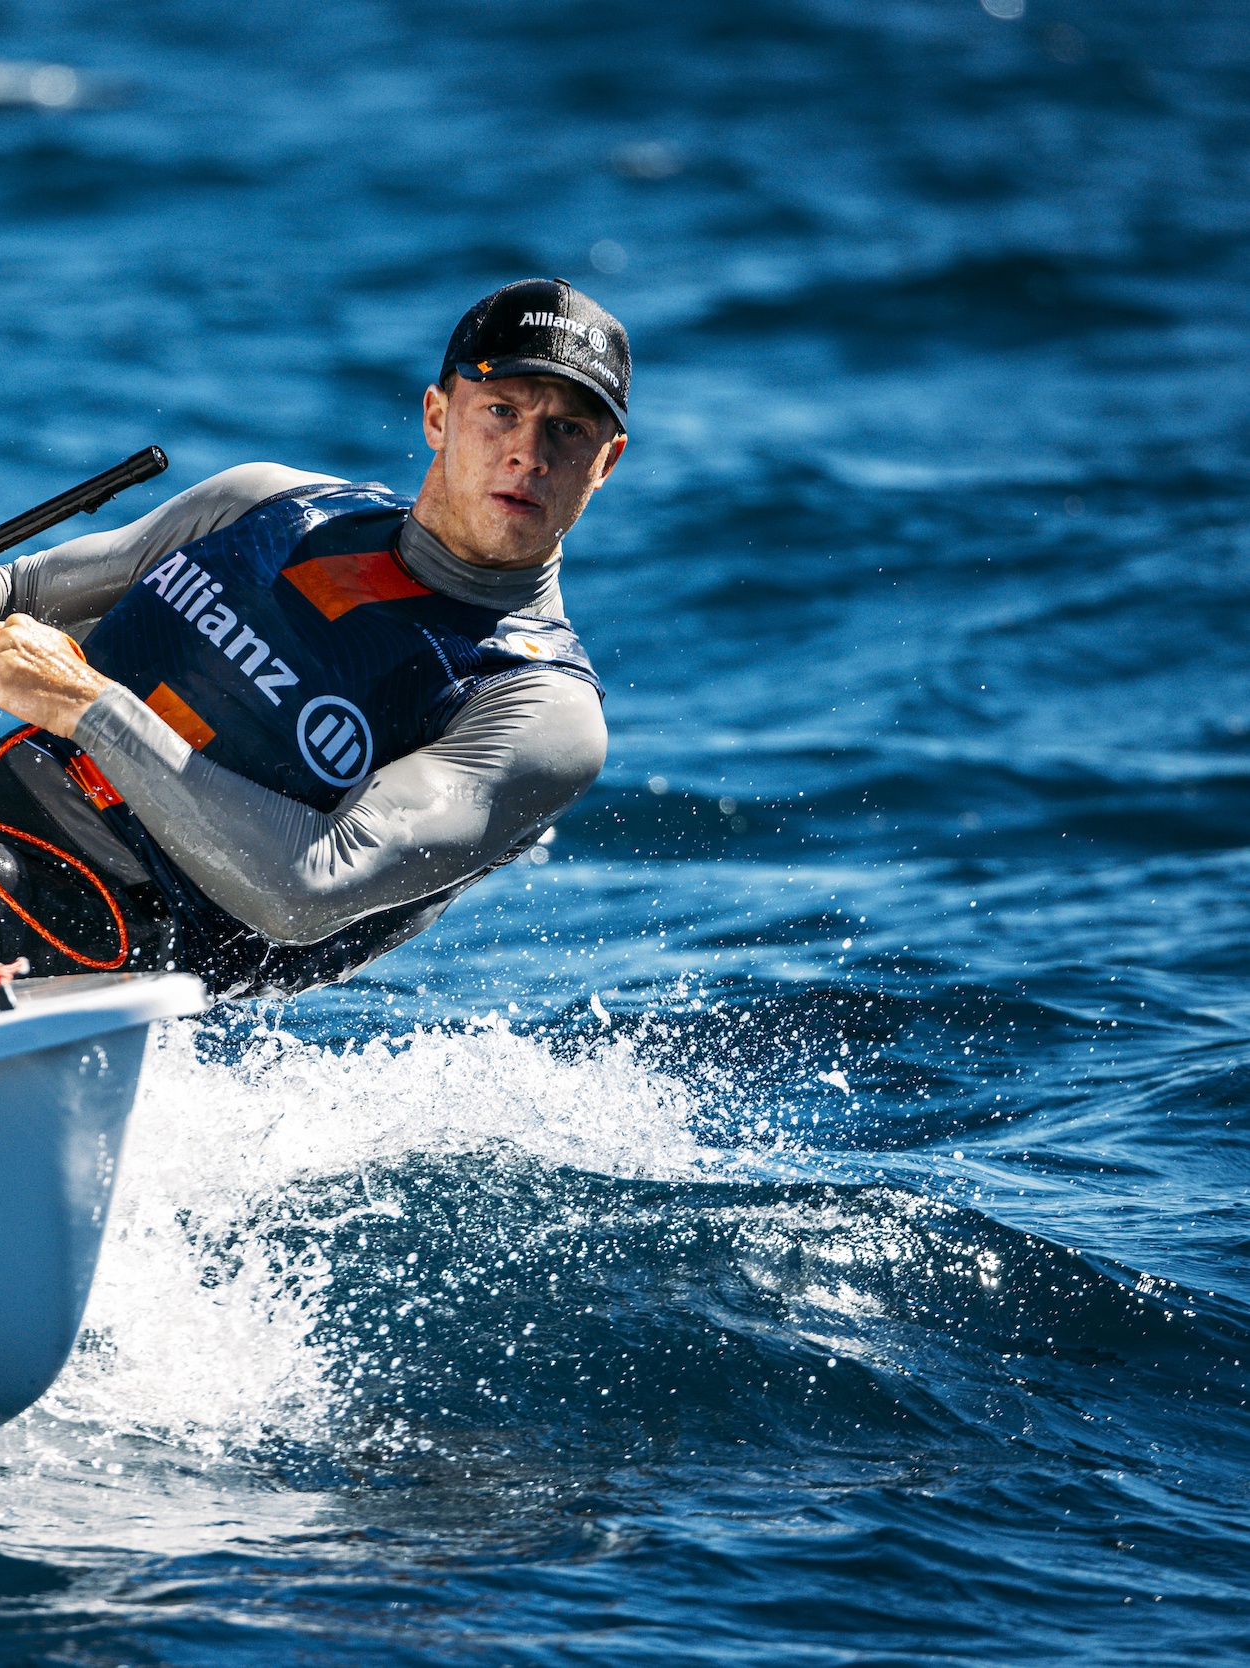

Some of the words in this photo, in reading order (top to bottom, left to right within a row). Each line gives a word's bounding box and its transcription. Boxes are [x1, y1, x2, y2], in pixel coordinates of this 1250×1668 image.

[519, 312, 587, 338] Allianz
[590, 359, 619, 389] MUSTO
[143, 551, 300, 707] Allianz
